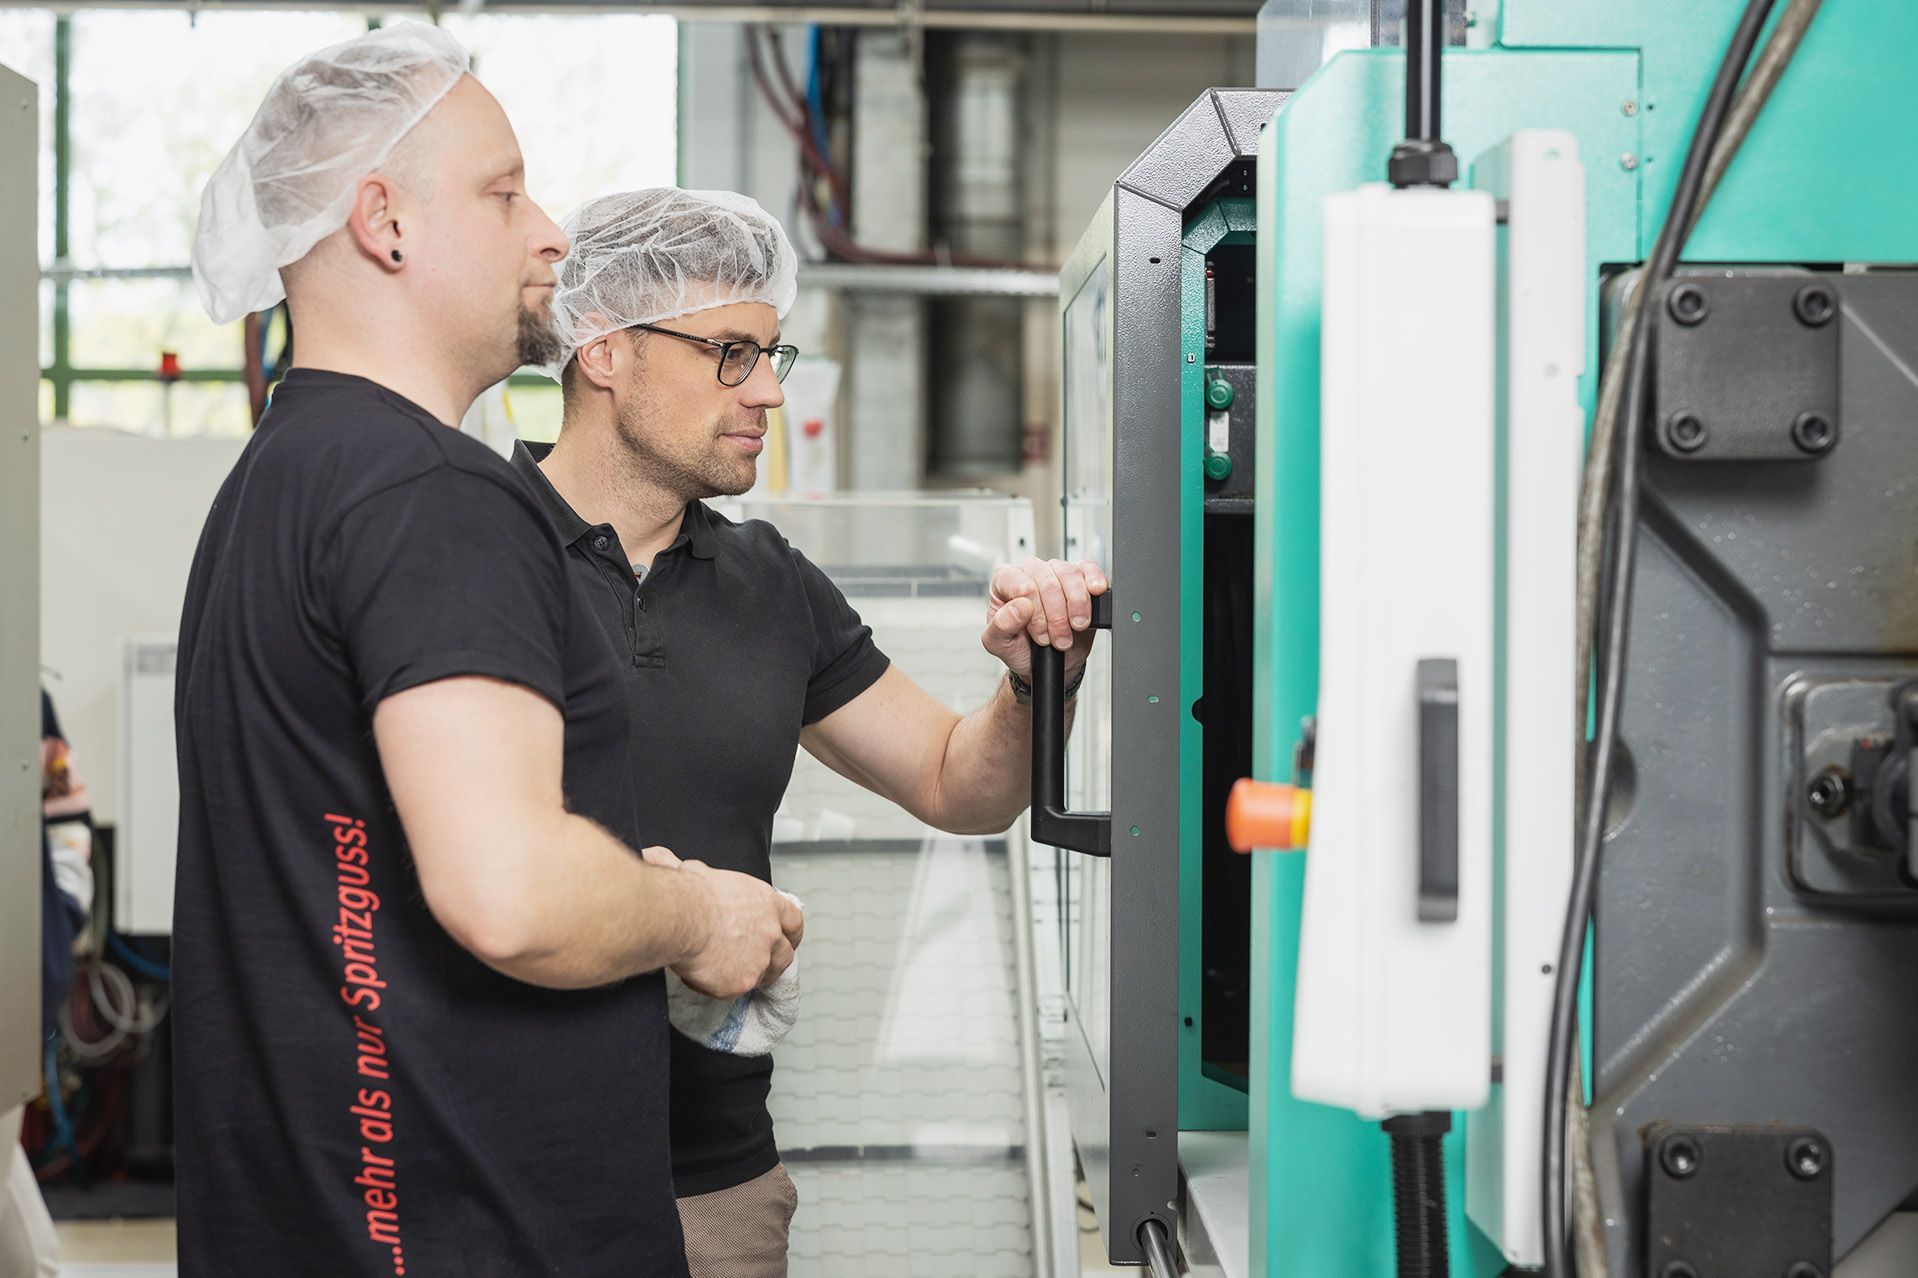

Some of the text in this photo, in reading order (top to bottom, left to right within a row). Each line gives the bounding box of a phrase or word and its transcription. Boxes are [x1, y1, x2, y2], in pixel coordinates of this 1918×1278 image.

[323, 812, 406, 1277] ...mehr als nur Spritzguss!
